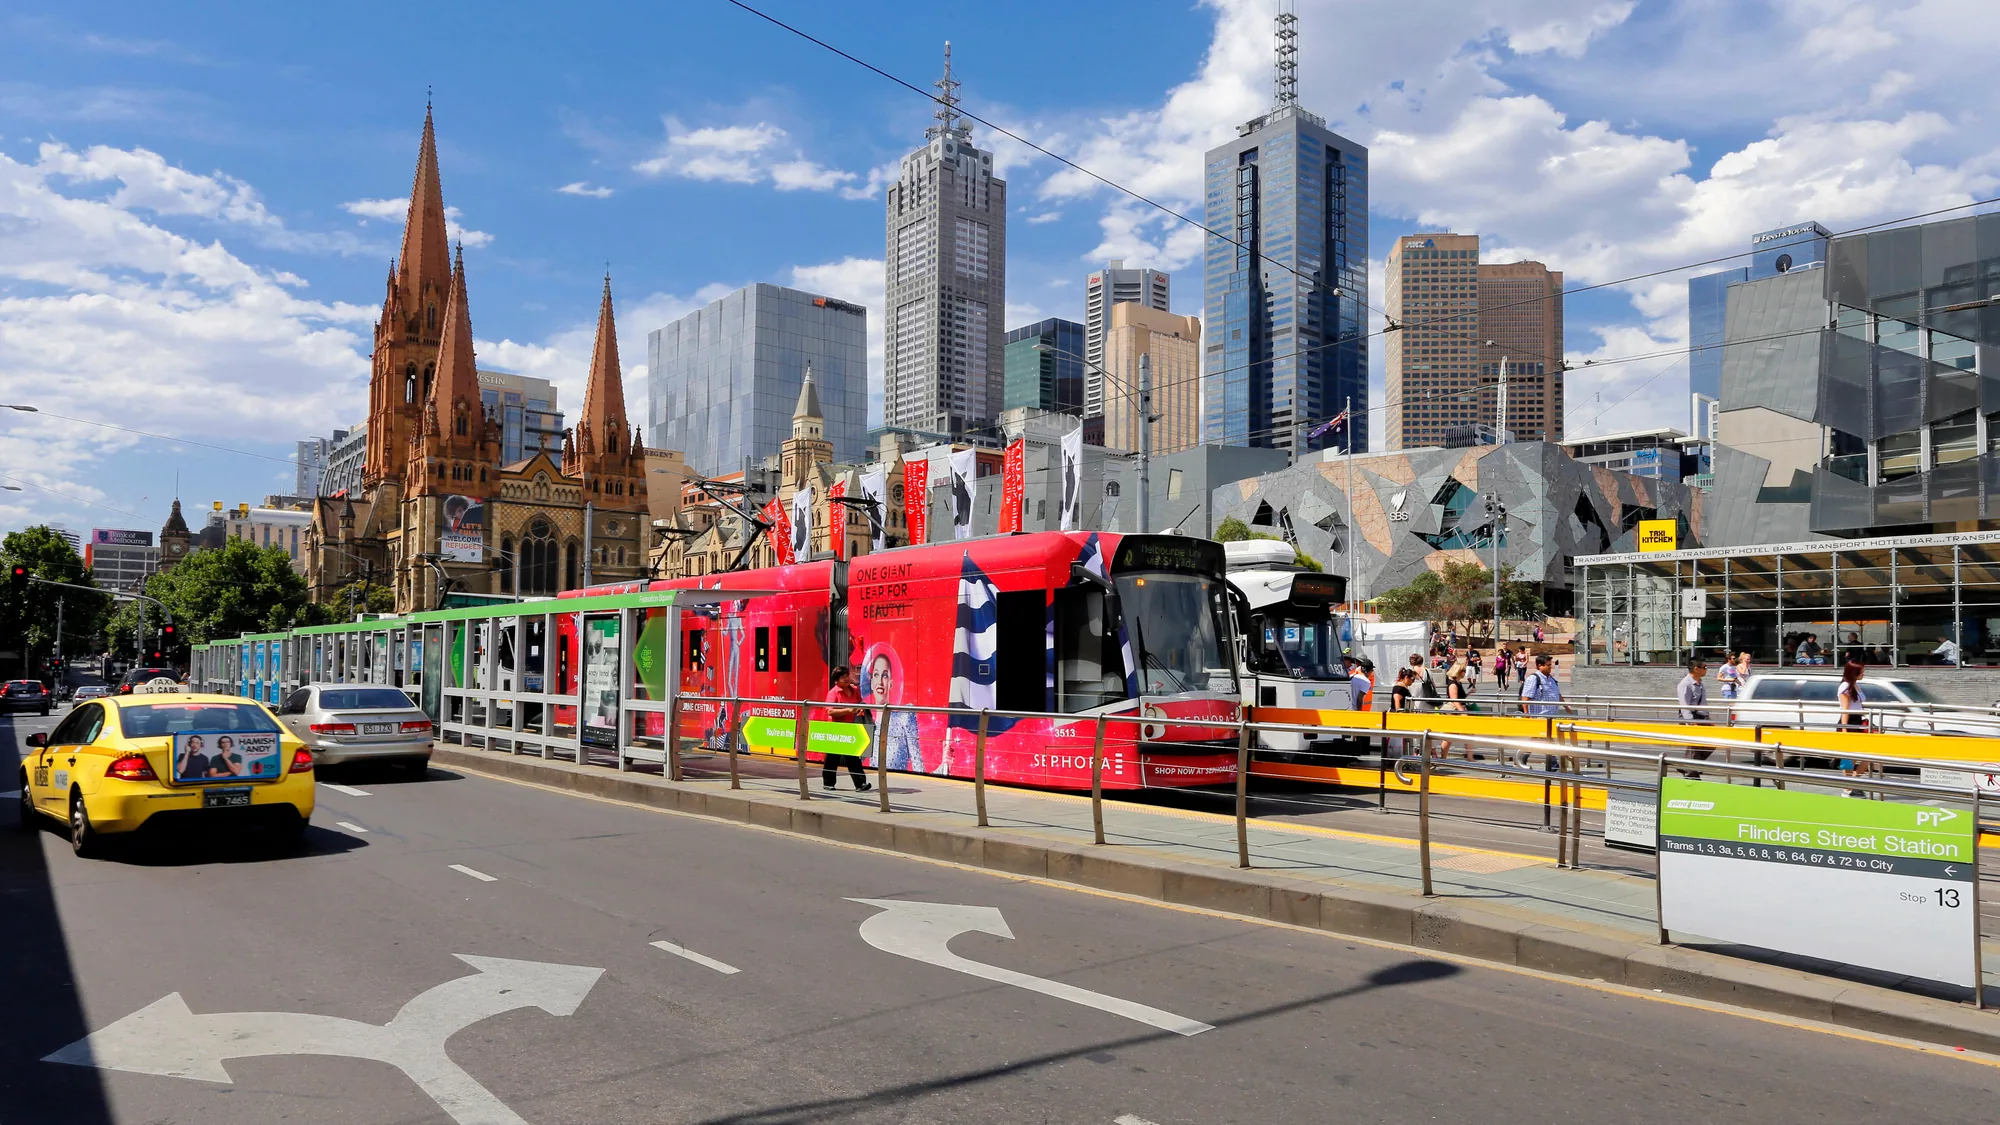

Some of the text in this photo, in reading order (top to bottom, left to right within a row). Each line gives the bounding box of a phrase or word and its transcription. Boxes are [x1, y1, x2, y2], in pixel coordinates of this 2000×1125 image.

[644, 450, 673, 458] REGENT
[1390, 511, 1408, 521] SBS
[447, 535, 482, 543] WELCOME
[445, 542, 482, 550] REFUGEES
[1142, 544, 1185, 556] Melbourne
[1575, 556, 1621, 564] TRANSPORT
[1682, 549, 1736, 557] TRANSPORT
[1804, 541, 1866, 550] TRANSPORT
[1870, 539, 1906, 547] HOTEL
[1163, 557, 1172, 566] St
[857, 563, 912, 581] ONE GIANT
[861, 583, 907, 600] LEAP FOR
[752, 707, 795, 718] NOVEMBER 2015
[766, 728, 780, 737] You're
[786, 730, 794, 738] the
[814, 732, 852, 743] FREE TRAM ZONE
[1054, 728, 1076, 737] 3513
[239, 737, 275, 745] HAMISH
[225, 796, 249, 805] 7465
[1611, 805, 1629, 813] strictly
[1610, 812, 1655, 822] Heavy penalties
[1738, 824, 1958, 857] Flinders Street Station
[1665, 840, 1893, 872] Trams 1, 3, 3a, 5, 6, 8, 16, 64, 67 & 72 to City
[1899, 887, 1960, 908] Stop 13
